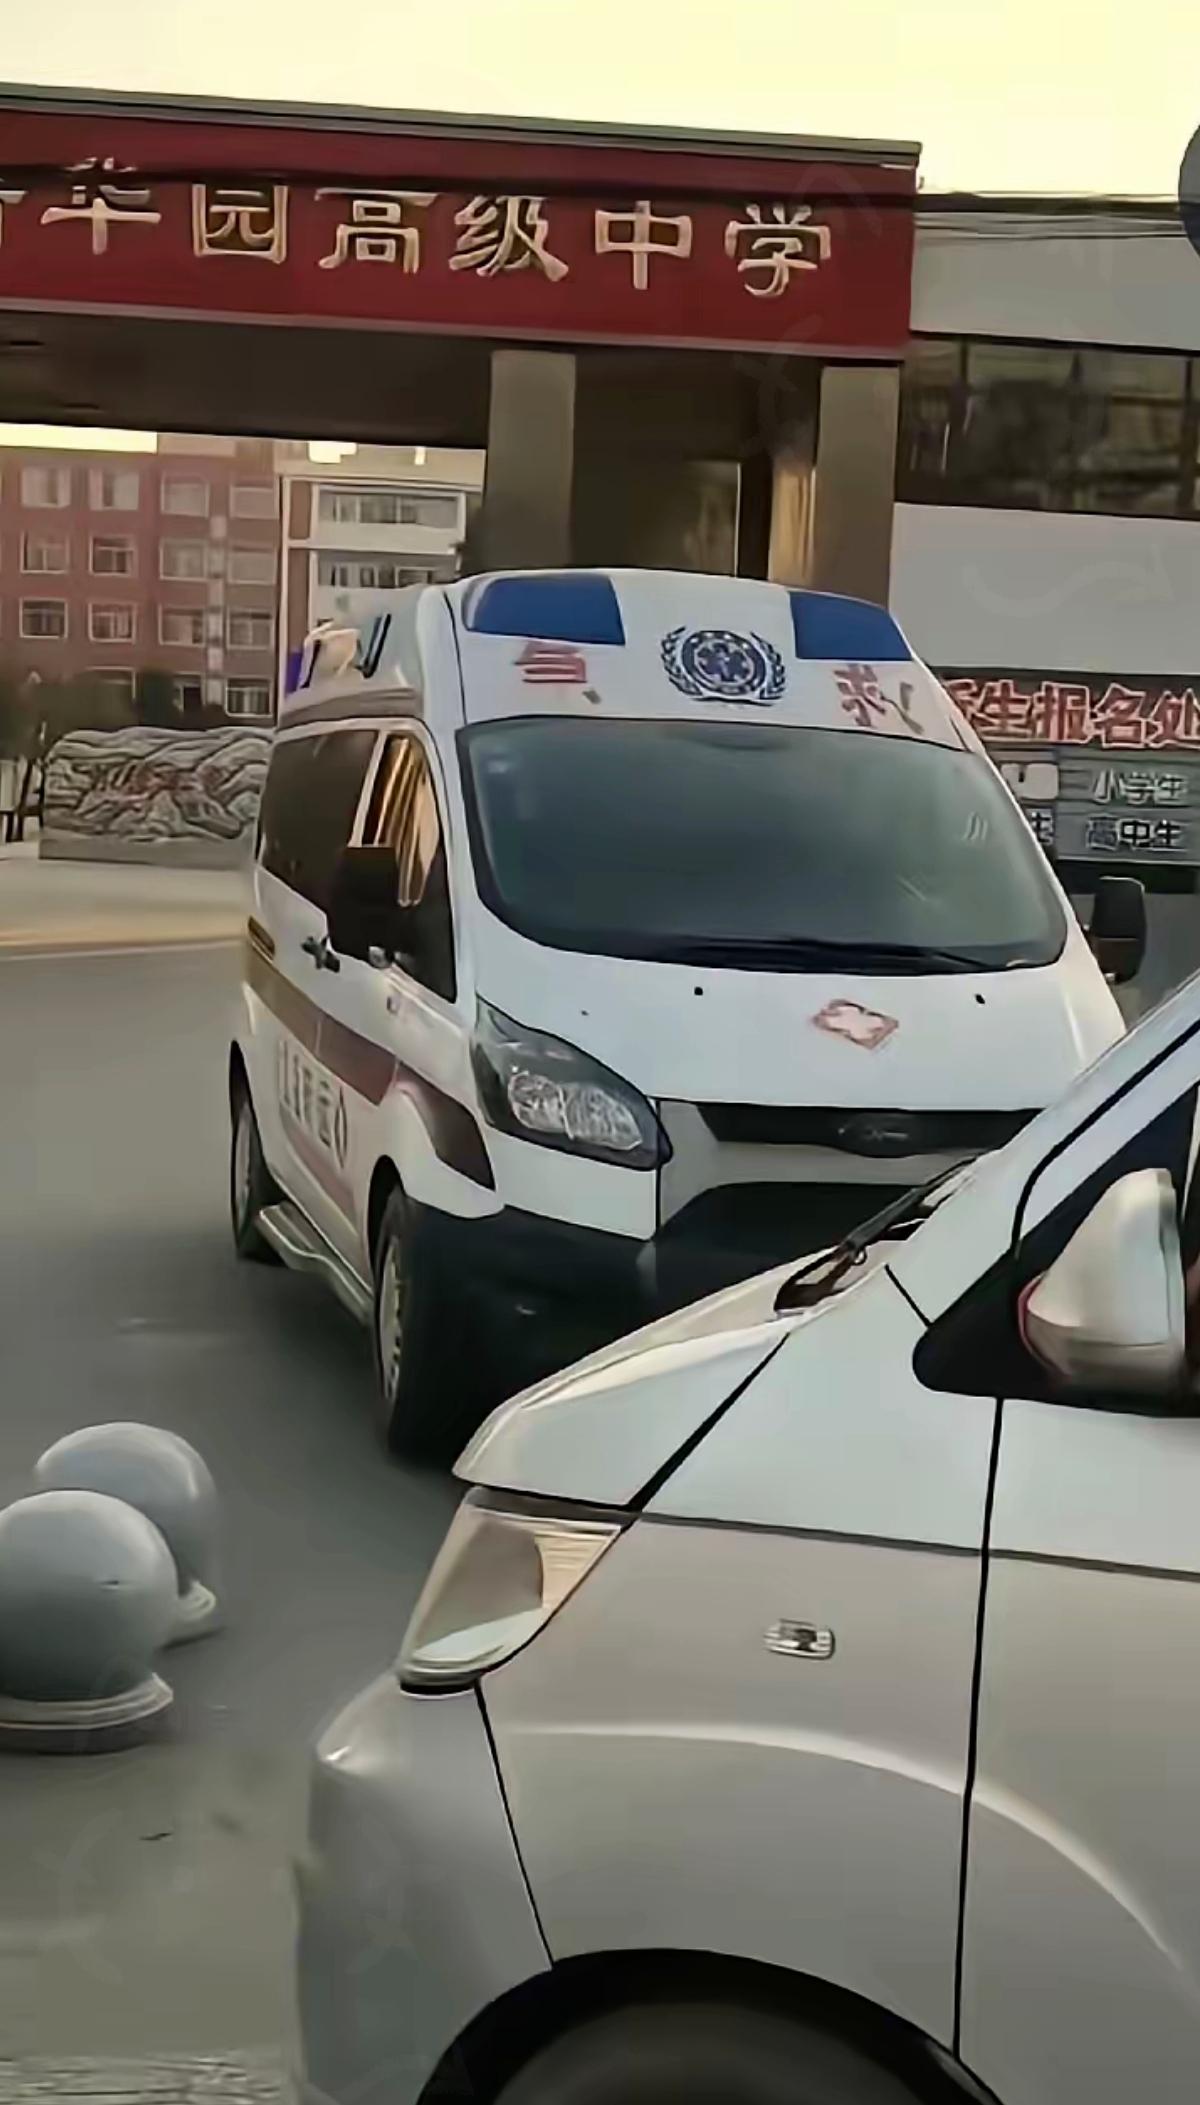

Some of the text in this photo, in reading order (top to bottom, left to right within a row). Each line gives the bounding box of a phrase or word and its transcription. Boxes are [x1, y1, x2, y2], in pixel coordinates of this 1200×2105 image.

[0, 156, 833, 297] 华园高级中学
